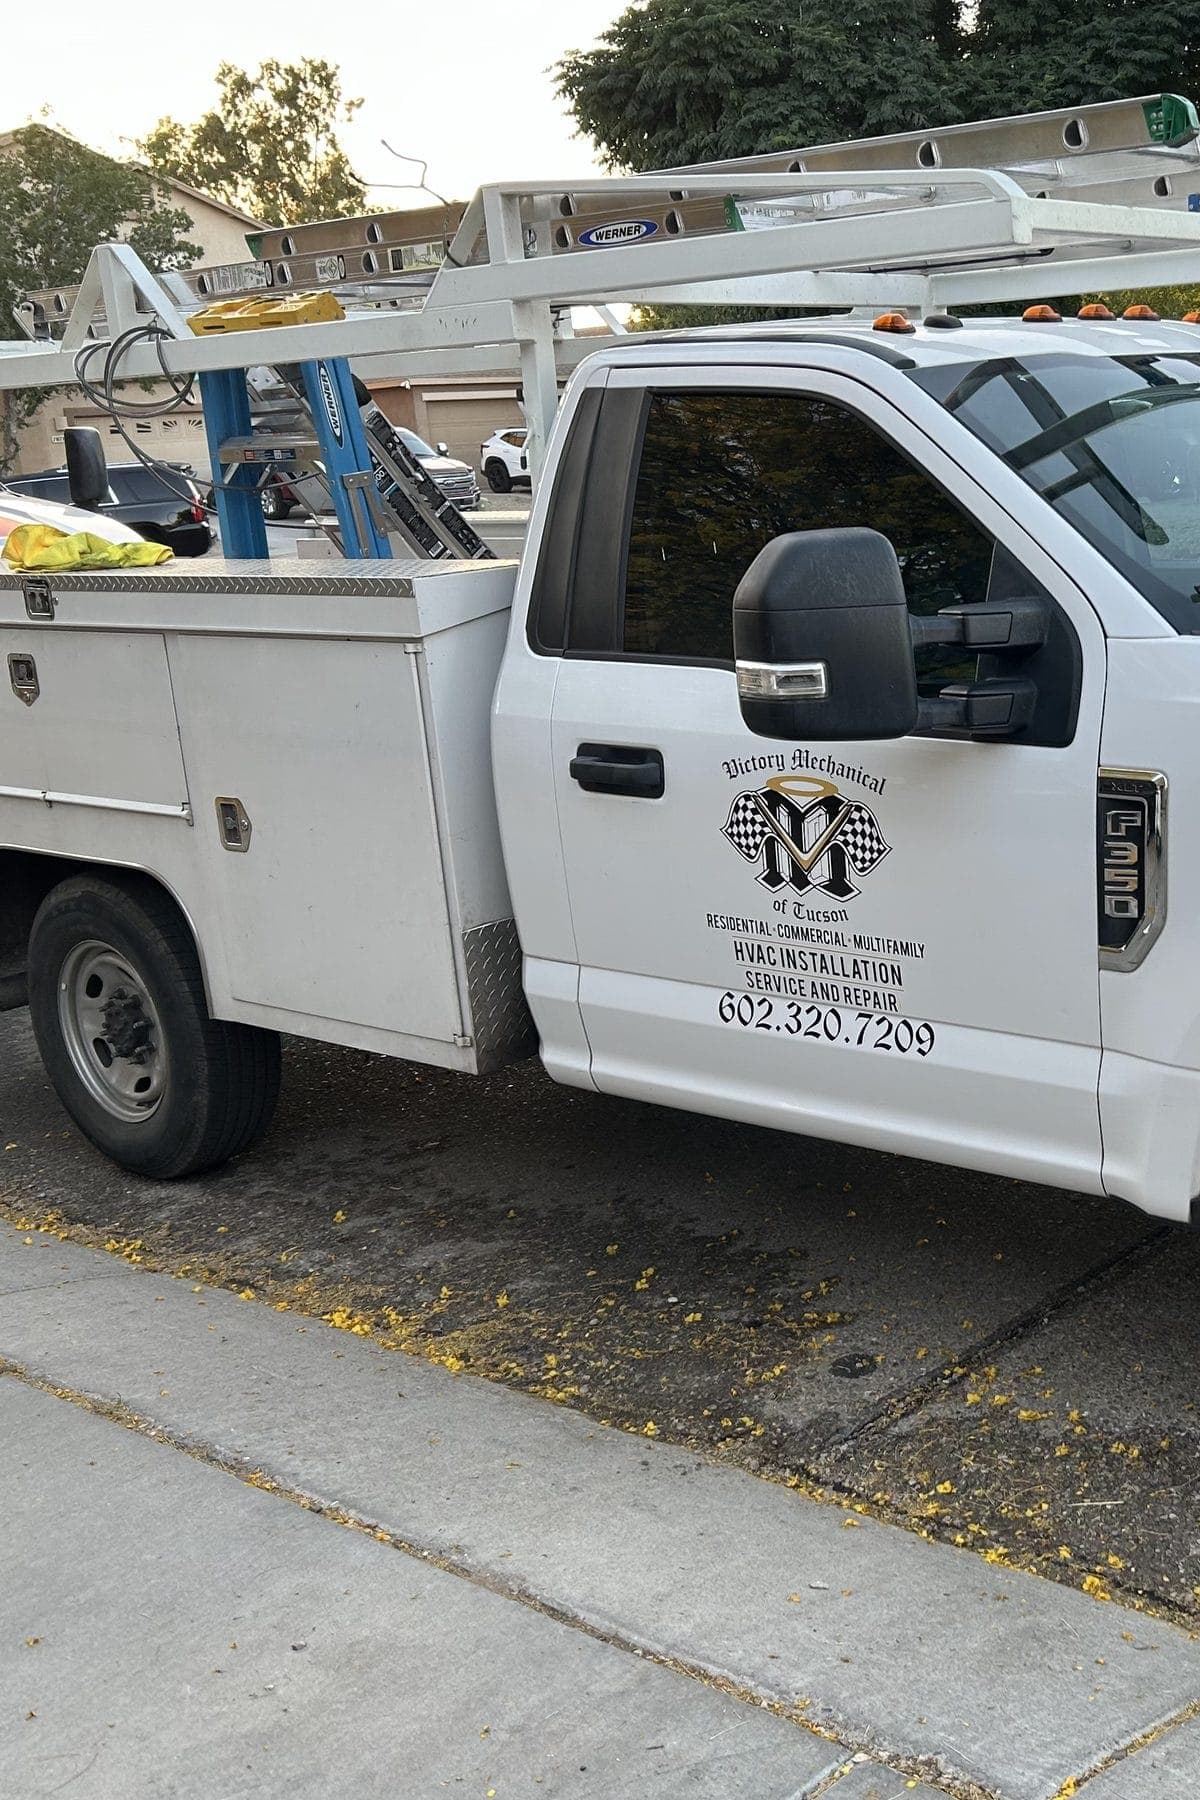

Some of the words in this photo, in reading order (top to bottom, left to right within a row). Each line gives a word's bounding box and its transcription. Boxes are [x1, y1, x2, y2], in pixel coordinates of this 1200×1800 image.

[595, 225, 641, 241] WERNER
[321, 373, 339, 430] WERNER
[722, 752, 785, 779] Victory
[790, 749, 888, 796] Mechanical
[1110, 782, 1143, 793] XLT
[1103, 811, 1142, 918] F350
[772, 899, 788, 915] of
[793, 901, 849, 923] Tucson
[706, 913, 772, 936] RESIDENTIAL
[777, 923, 848, 948] COMMERCIAL
[853, 934, 926, 959] MULTIFAMILY
[733, 940, 777, 966] HVAC
[780, 947, 903, 986] INSTALLATION
[745, 971, 807, 997] SERVICE
[811, 981, 840, 1002] AND
[844, 987, 898, 1013] REPAIR
[718, 991, 936, 1057] 602.320.7209
